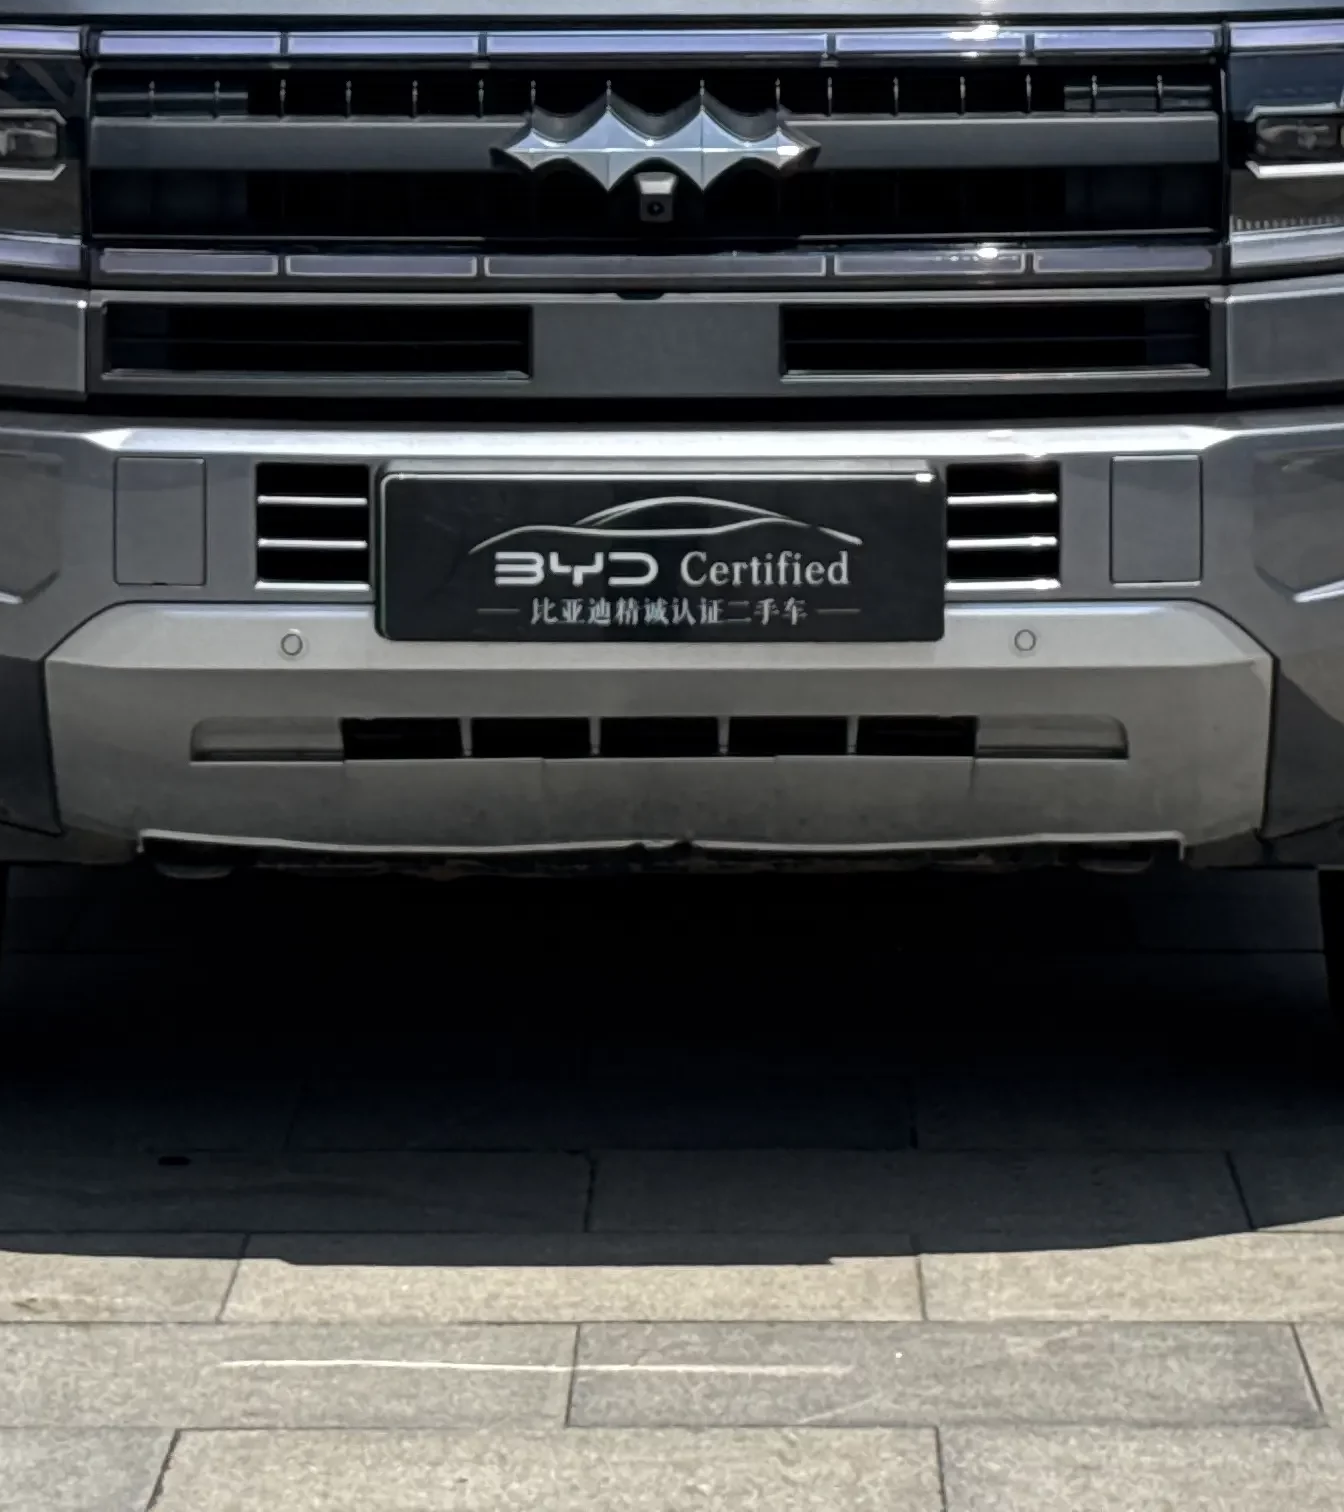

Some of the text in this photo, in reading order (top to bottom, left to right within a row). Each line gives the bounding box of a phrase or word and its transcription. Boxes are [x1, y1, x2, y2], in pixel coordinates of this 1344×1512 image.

[494, 550, 850, 587] BYD Certified
[529, 596, 809, 626] 比亚迪精诚认证二手车
